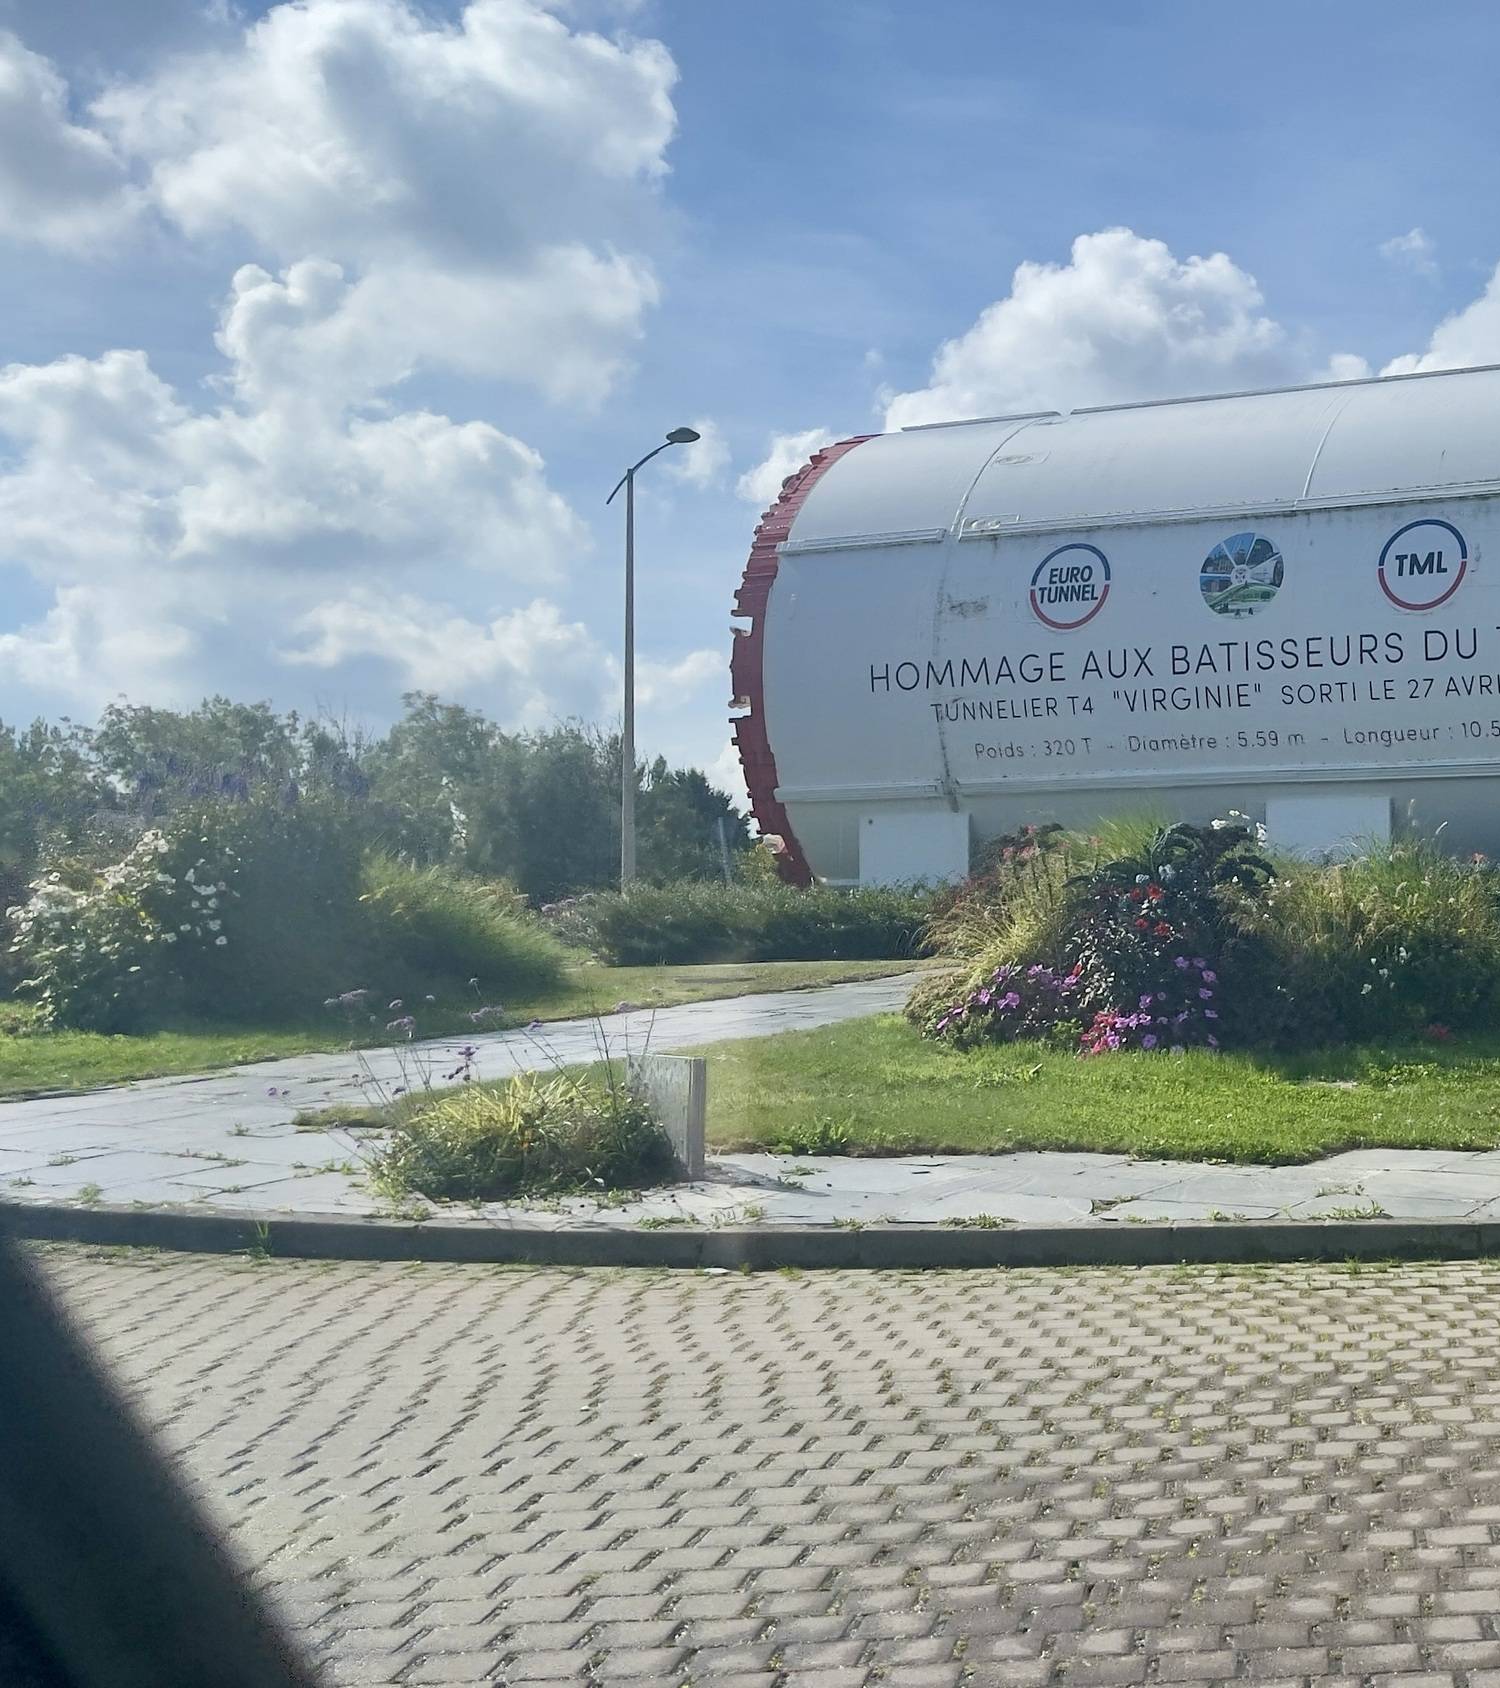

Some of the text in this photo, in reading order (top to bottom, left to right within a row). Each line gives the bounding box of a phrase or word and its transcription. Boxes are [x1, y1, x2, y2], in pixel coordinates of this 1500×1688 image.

[1048, 565, 1093, 585] EURO
[1395, 550, 1448, 577] TML
[1038, 584, 1099, 604] TUNNEL
[869, 651, 1066, 693] HOMMAGE
[1081, 646, 1154, 681] AUX
[1171, 632, 1405, 676] BATISSEURS
[1424, 627, 1478, 662] DU
[930, 697, 1059, 723] TUNNELIER
[1067, 695, 1095, 716] T4
[1112, 682, 1262, 713] "VIRGINIE"
[1281, 682, 1358, 706] SORTI
[1369, 679, 1396, 701] LE
[1408, 677, 1435, 700] 27
[974, 742, 1025, 761] Poids
[1043, 738, 1076, 757] 320
[1081, 737, 1092, 755] T
[1127, 734, 1218, 752] Diamètre
[1237, 730, 1280, 748] 5.59
[1287, 732, 1305, 745] m
[1343, 726, 1440, 748] Longueur
